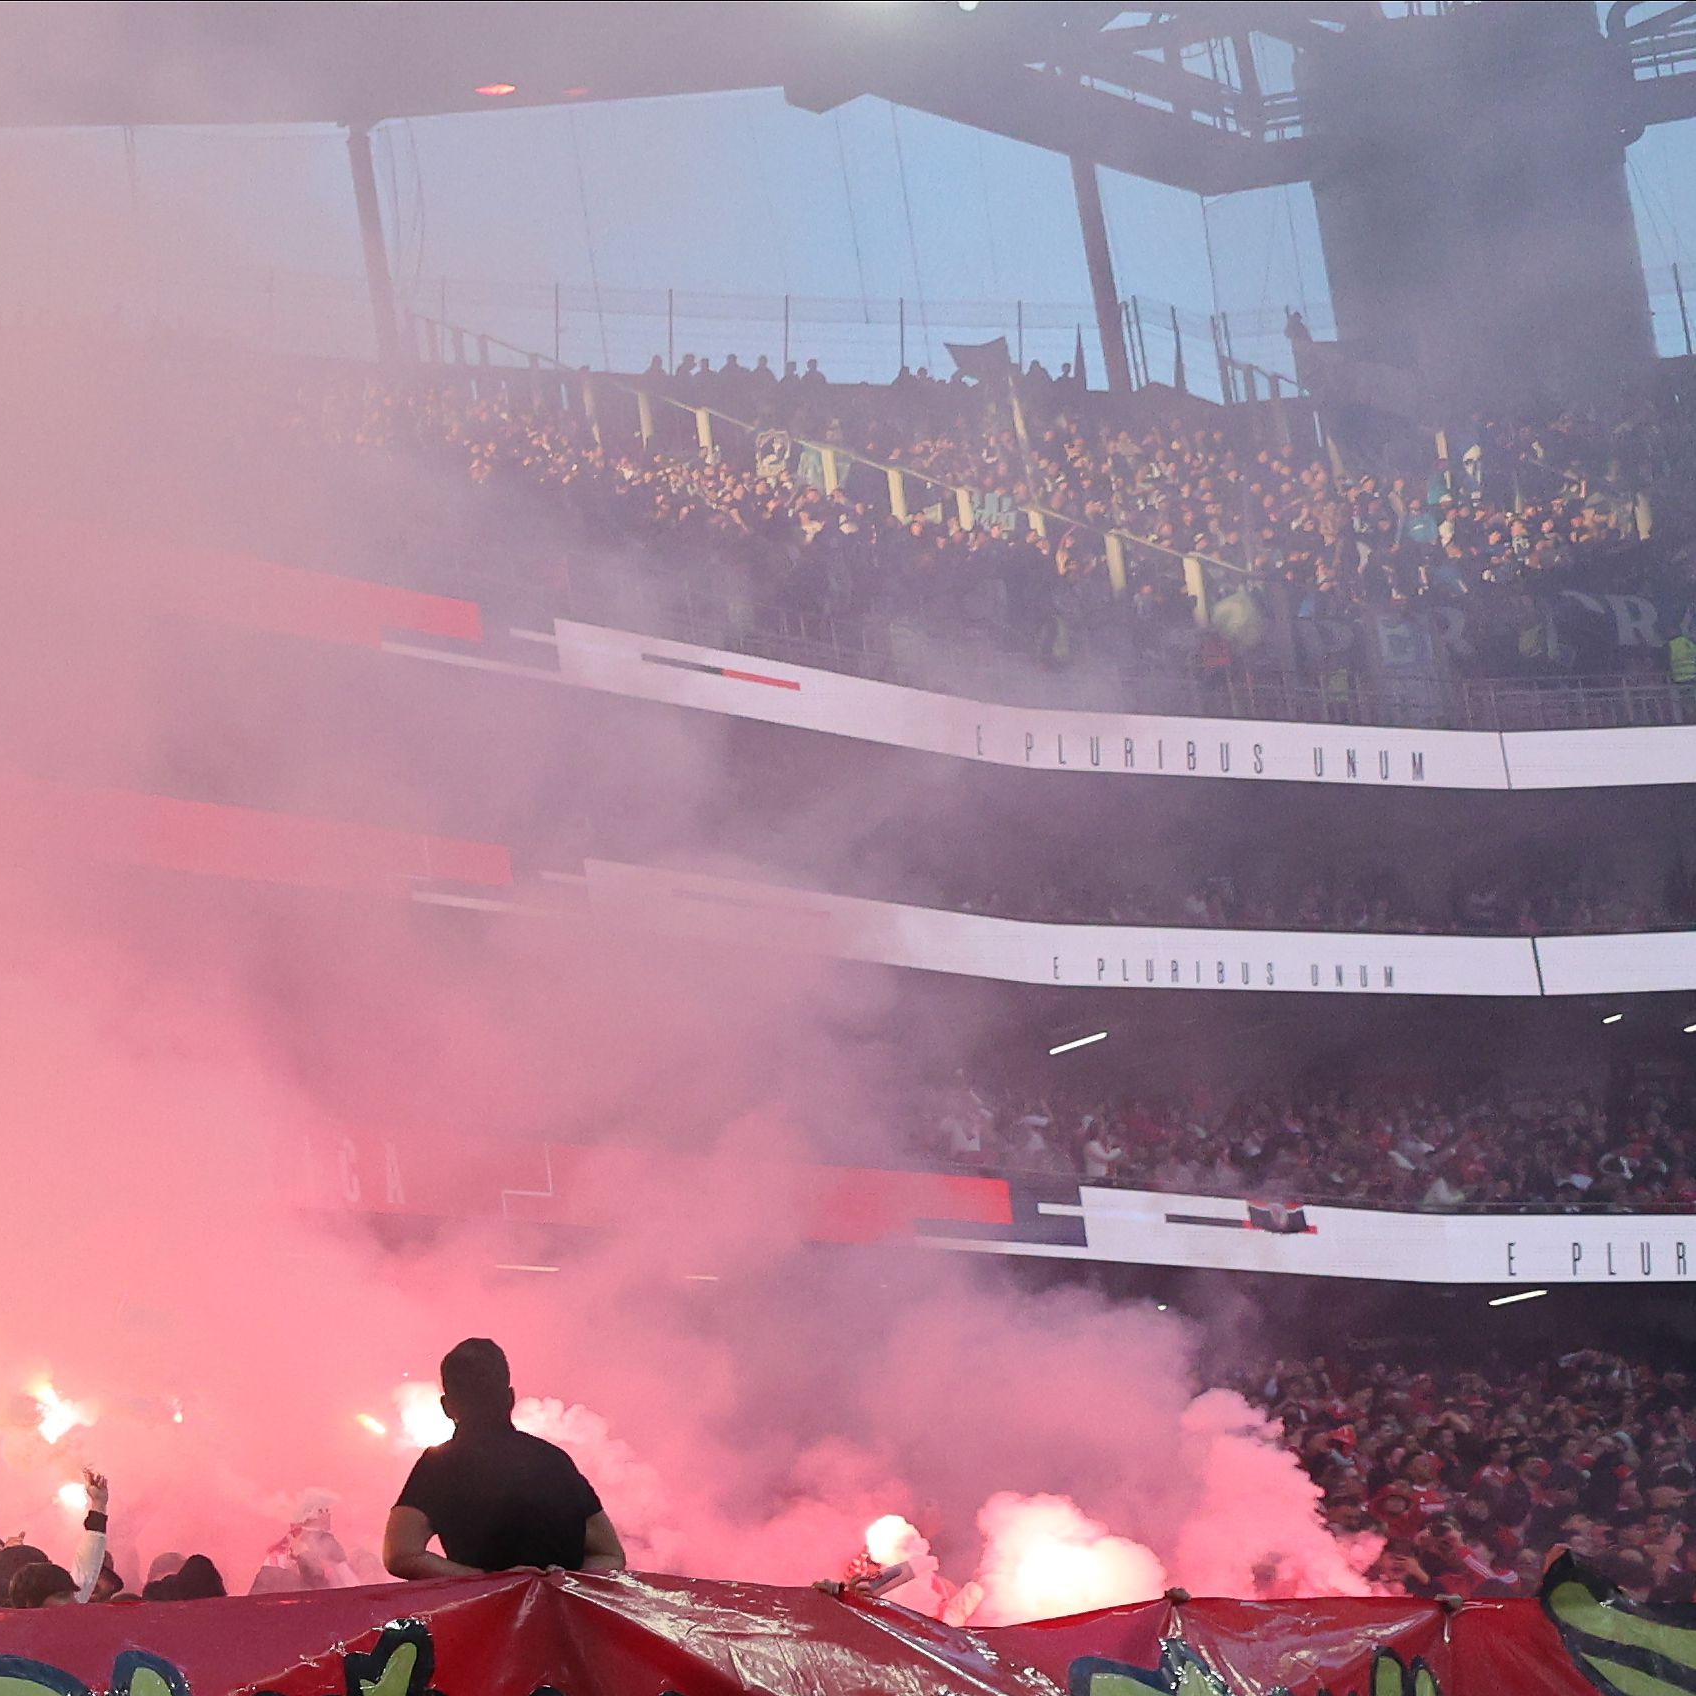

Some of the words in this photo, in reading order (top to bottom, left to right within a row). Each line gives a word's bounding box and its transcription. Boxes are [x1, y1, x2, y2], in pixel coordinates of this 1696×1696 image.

[975, 725, 984, 757] E
[1025, 731, 1264, 774] PLURIBUS
[1312, 746, 1425, 782] UNUM
[1052, 956, 1061, 980] E
[1096, 957, 1276, 986] PLURIBUS
[1311, 963, 1395, 988] UNUM
[1507, 1241, 1518, 1277] E
[1570, 1241, 1688, 1277] PLUR
